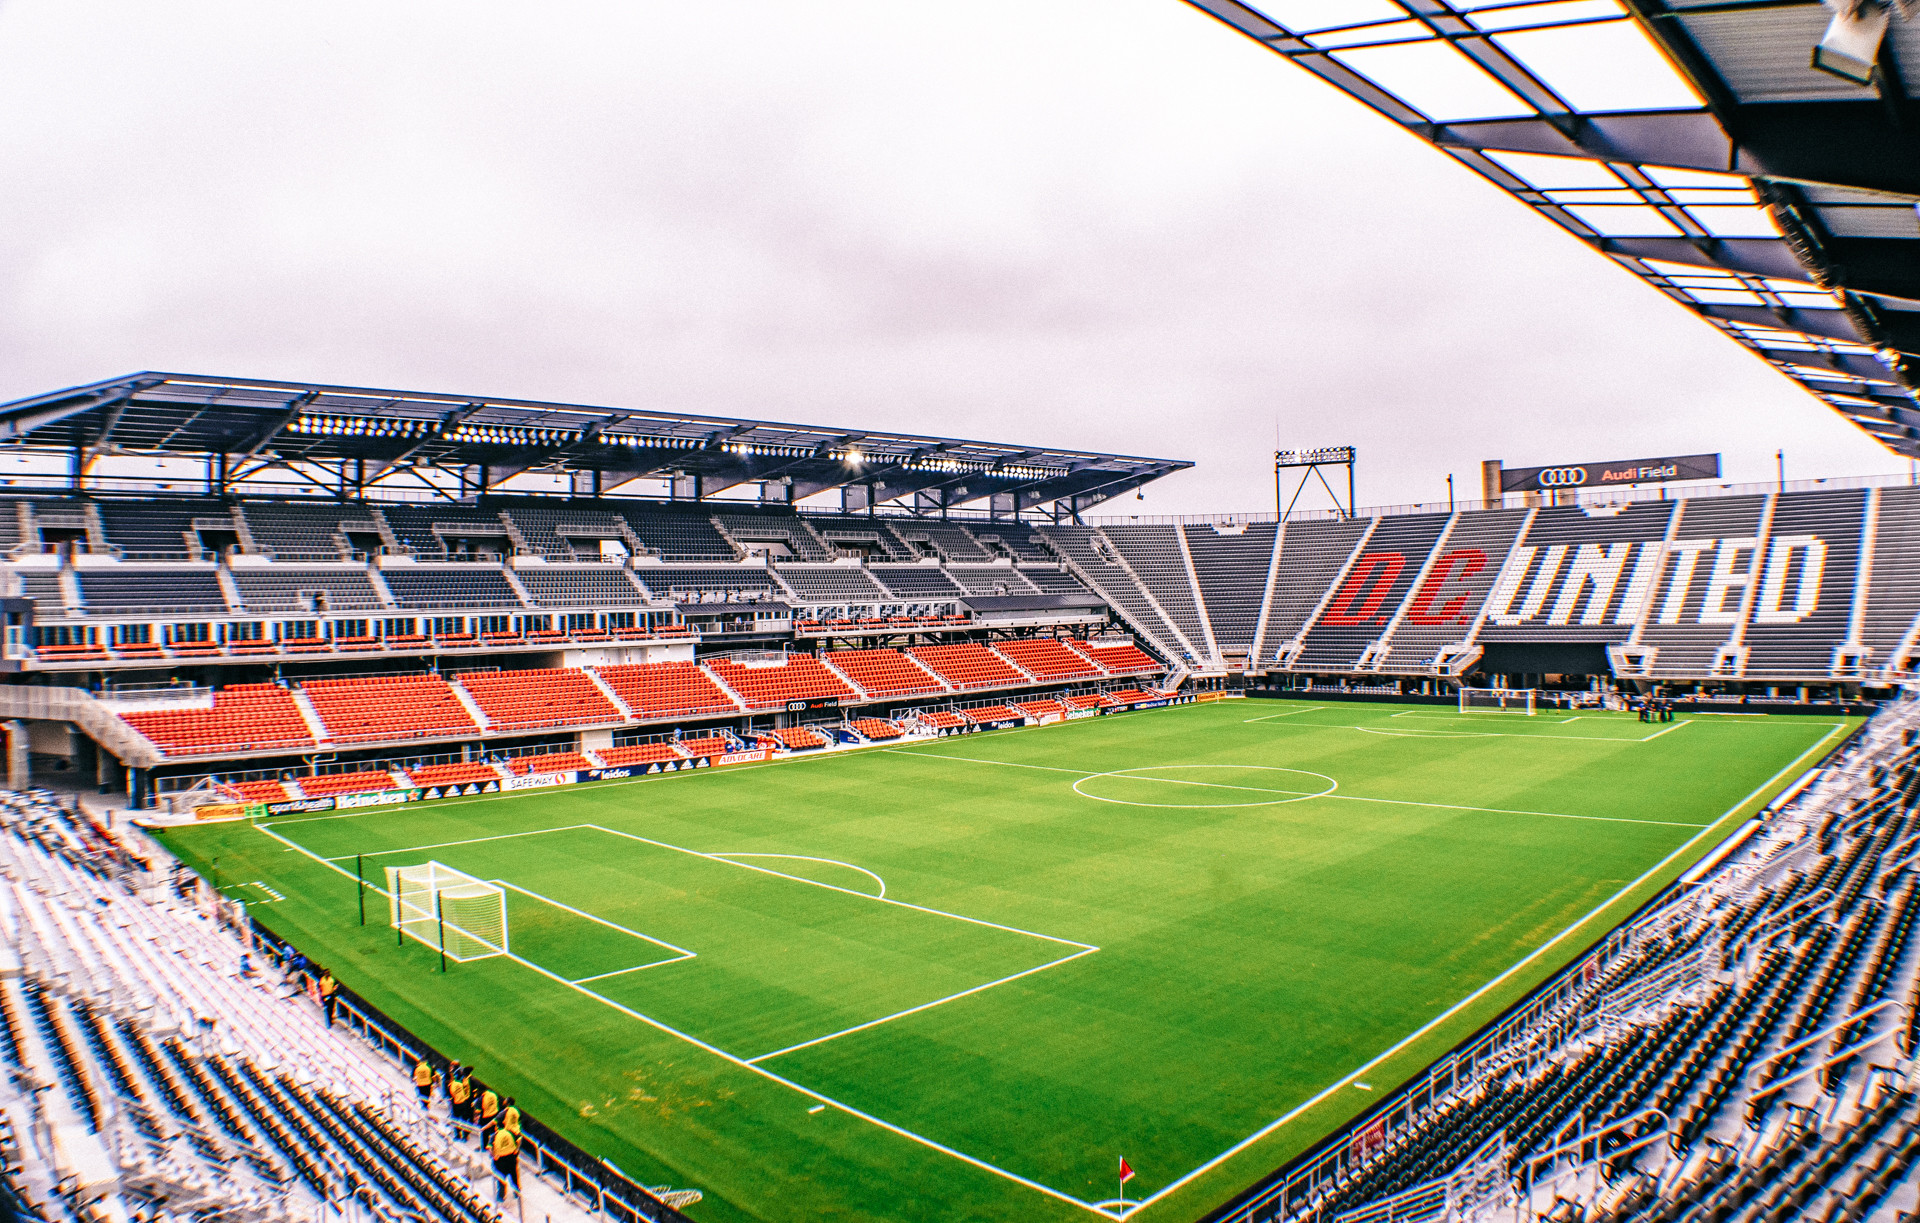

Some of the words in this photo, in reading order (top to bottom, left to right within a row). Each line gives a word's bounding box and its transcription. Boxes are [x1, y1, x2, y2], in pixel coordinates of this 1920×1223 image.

[1602, 468, 1637, 482] Audi
[1638, 464, 1678, 479] Field
[1487, 535, 1828, 627] UNITED
[997, 720, 1014, 730] leidos
[720, 751, 764, 764] ADVOCARE
[510, 774, 553, 789] SAFEWAY
[601, 768, 630, 781] leidos
[338, 792, 407, 809] Heineken
